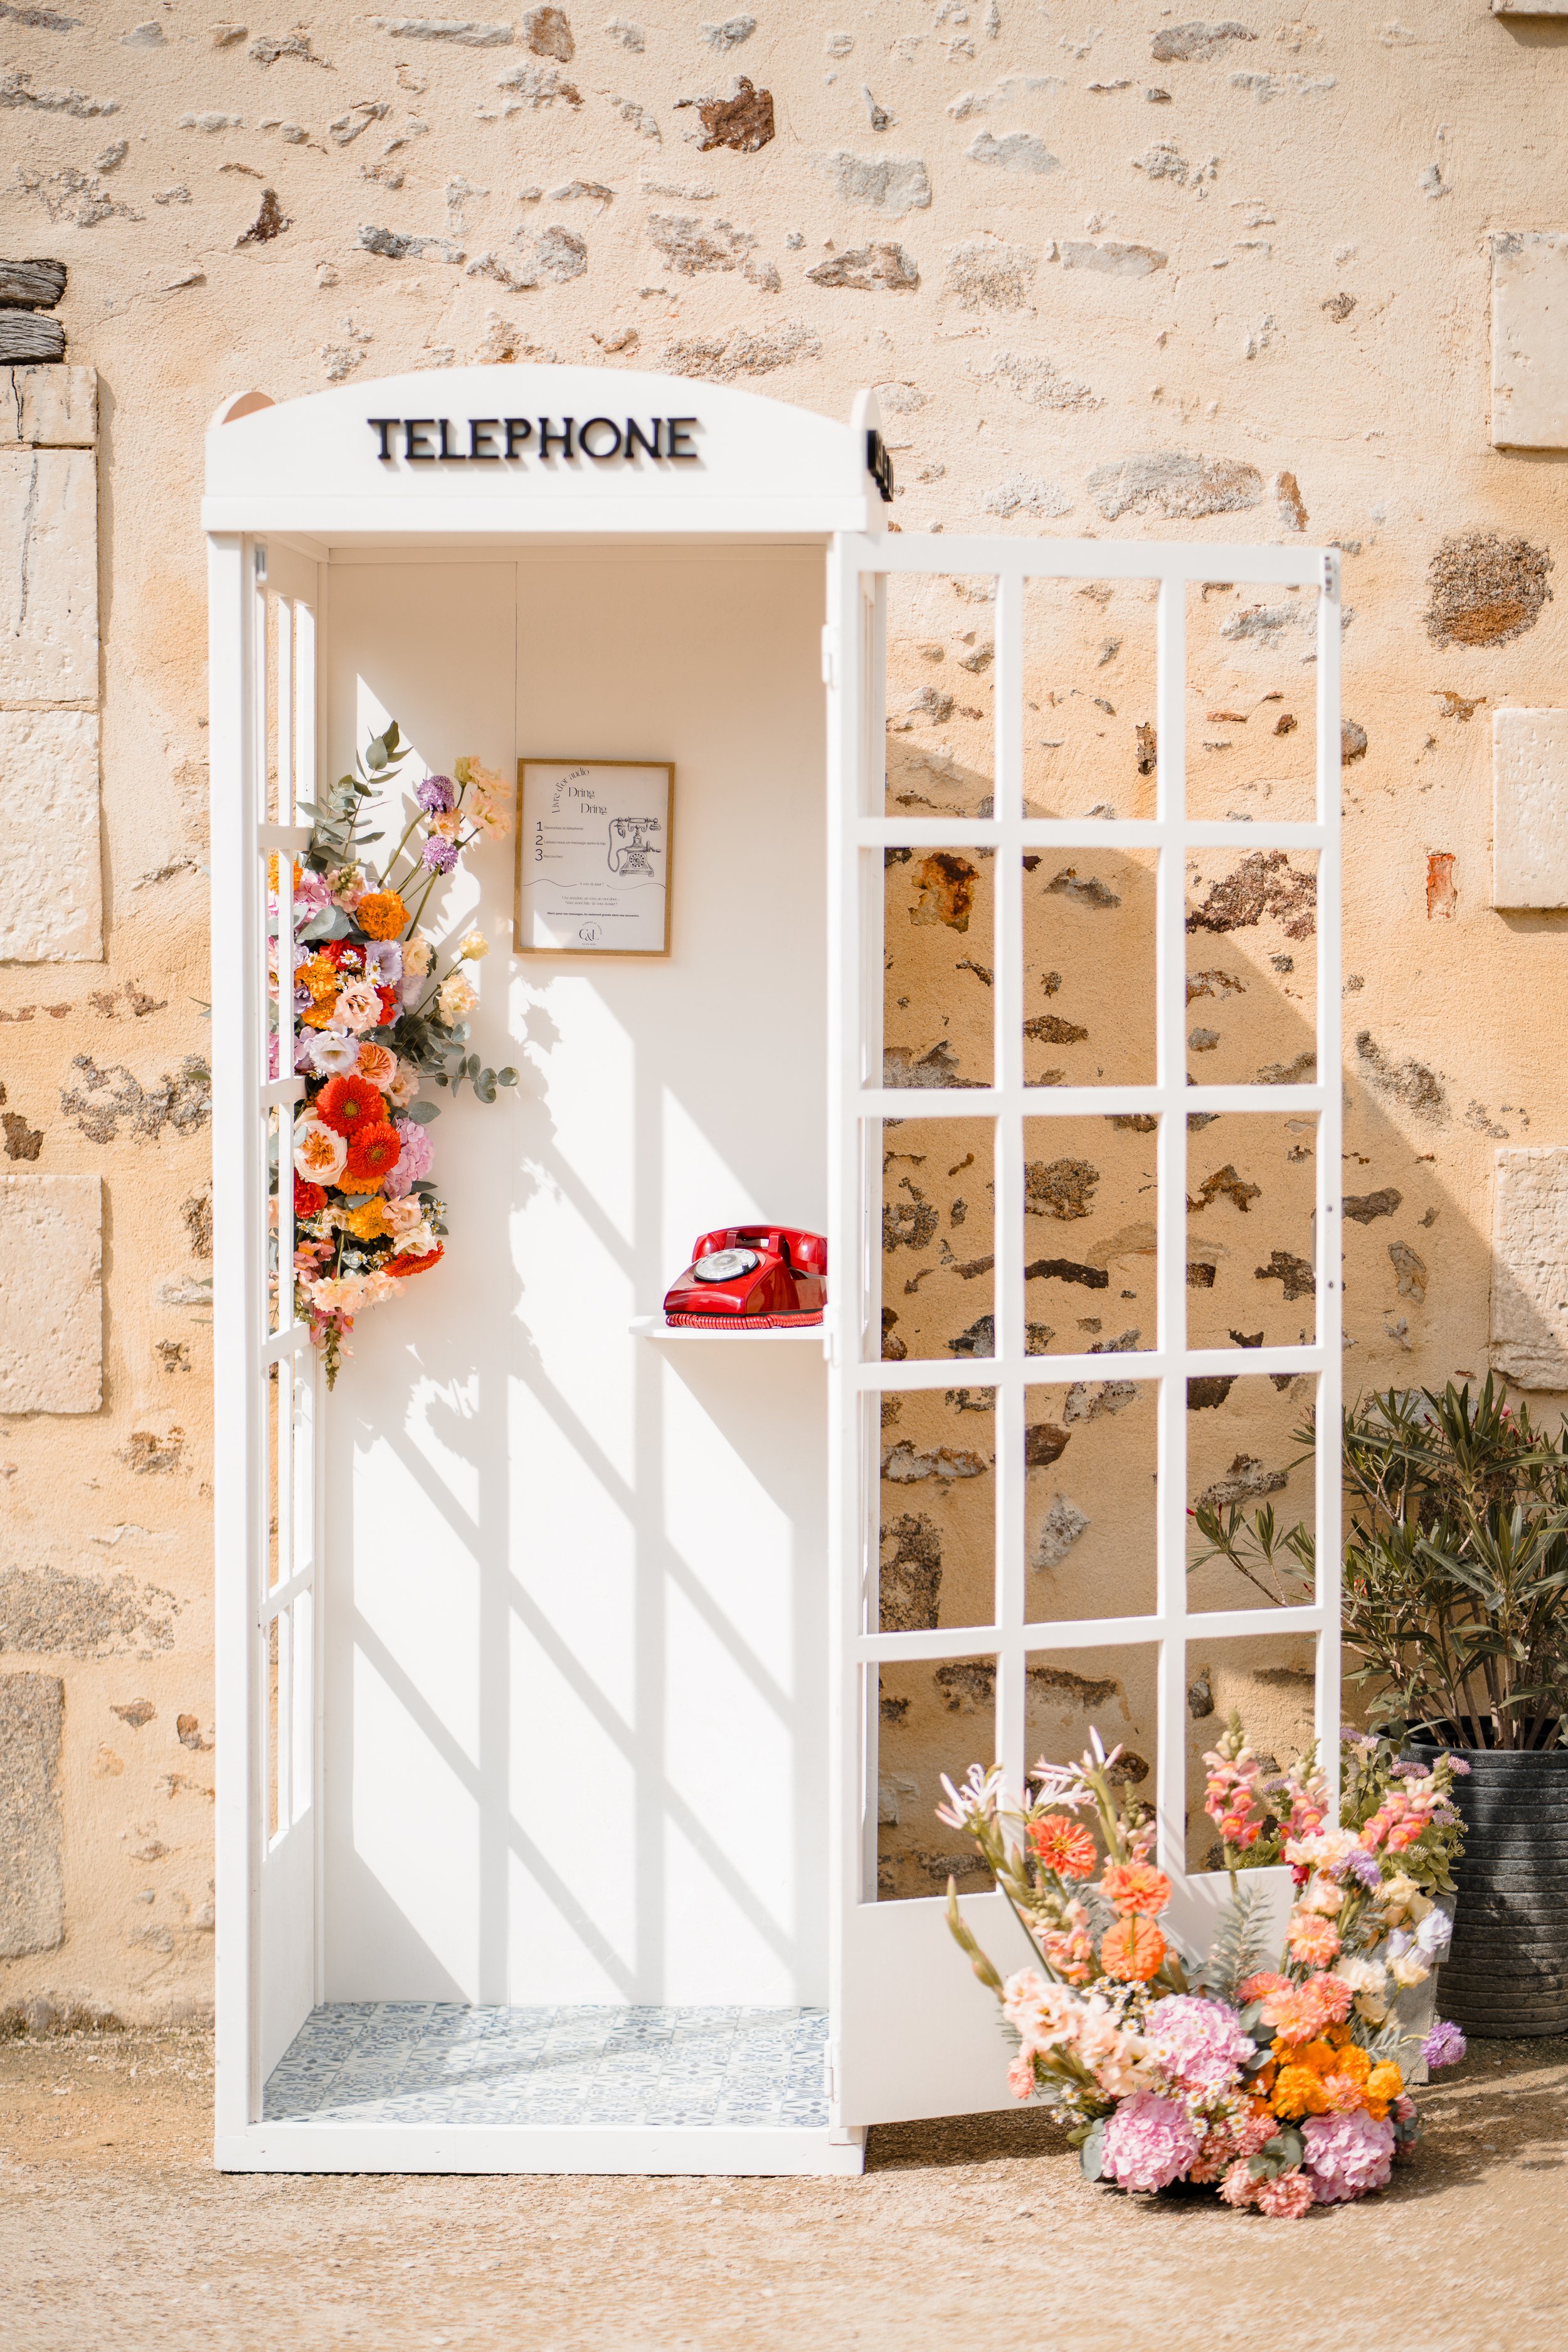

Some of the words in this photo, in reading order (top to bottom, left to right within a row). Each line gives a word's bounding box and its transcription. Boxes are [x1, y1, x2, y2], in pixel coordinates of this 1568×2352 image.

[367, 418, 697, 460] TELEPHONE
[568, 767, 590, 780] audio
[555, 777, 568, 792] d'or
[568, 787, 595, 799] Dring
[551, 793, 561, 813] Livre
[581, 803, 608, 815] Dring
[536, 821, 543, 832] 1
[535, 835, 543, 845] 2
[535, 849, 543, 861] 3
[579, 928, 599, 941] C&L
